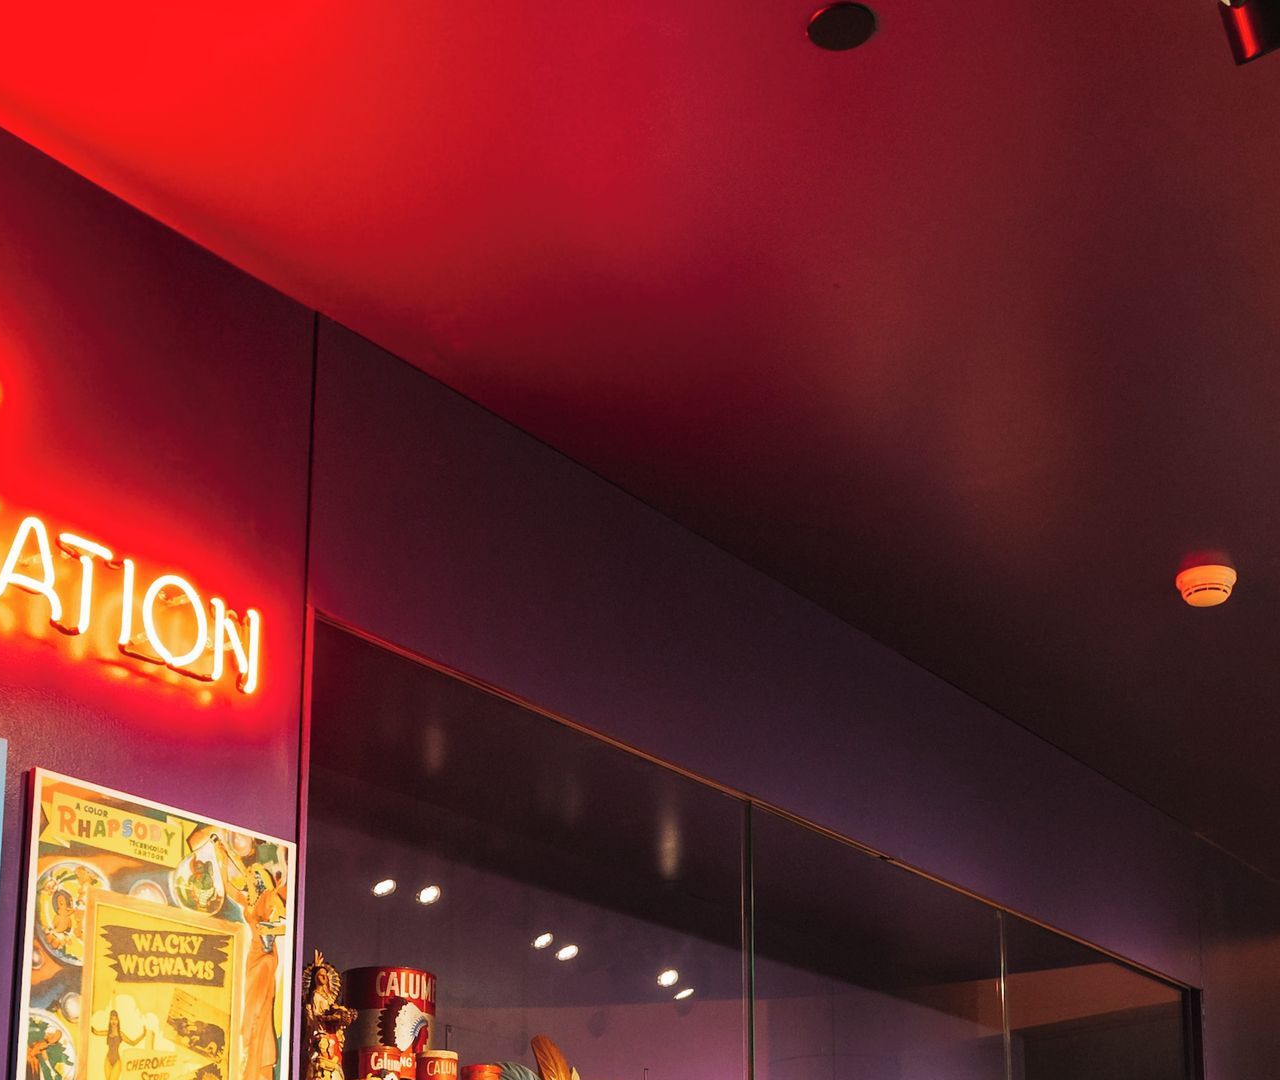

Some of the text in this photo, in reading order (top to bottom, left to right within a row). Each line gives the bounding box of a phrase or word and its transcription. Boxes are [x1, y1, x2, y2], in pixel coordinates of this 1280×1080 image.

[75, 802, 109, 818] A COLOR
[57, 805, 176, 846] RHAPSODY
[132, 933, 203, 955] WACKY
[118, 954, 215, 980] WIGWAMS
[126, 1054, 177, 1072] CHEROKEE
